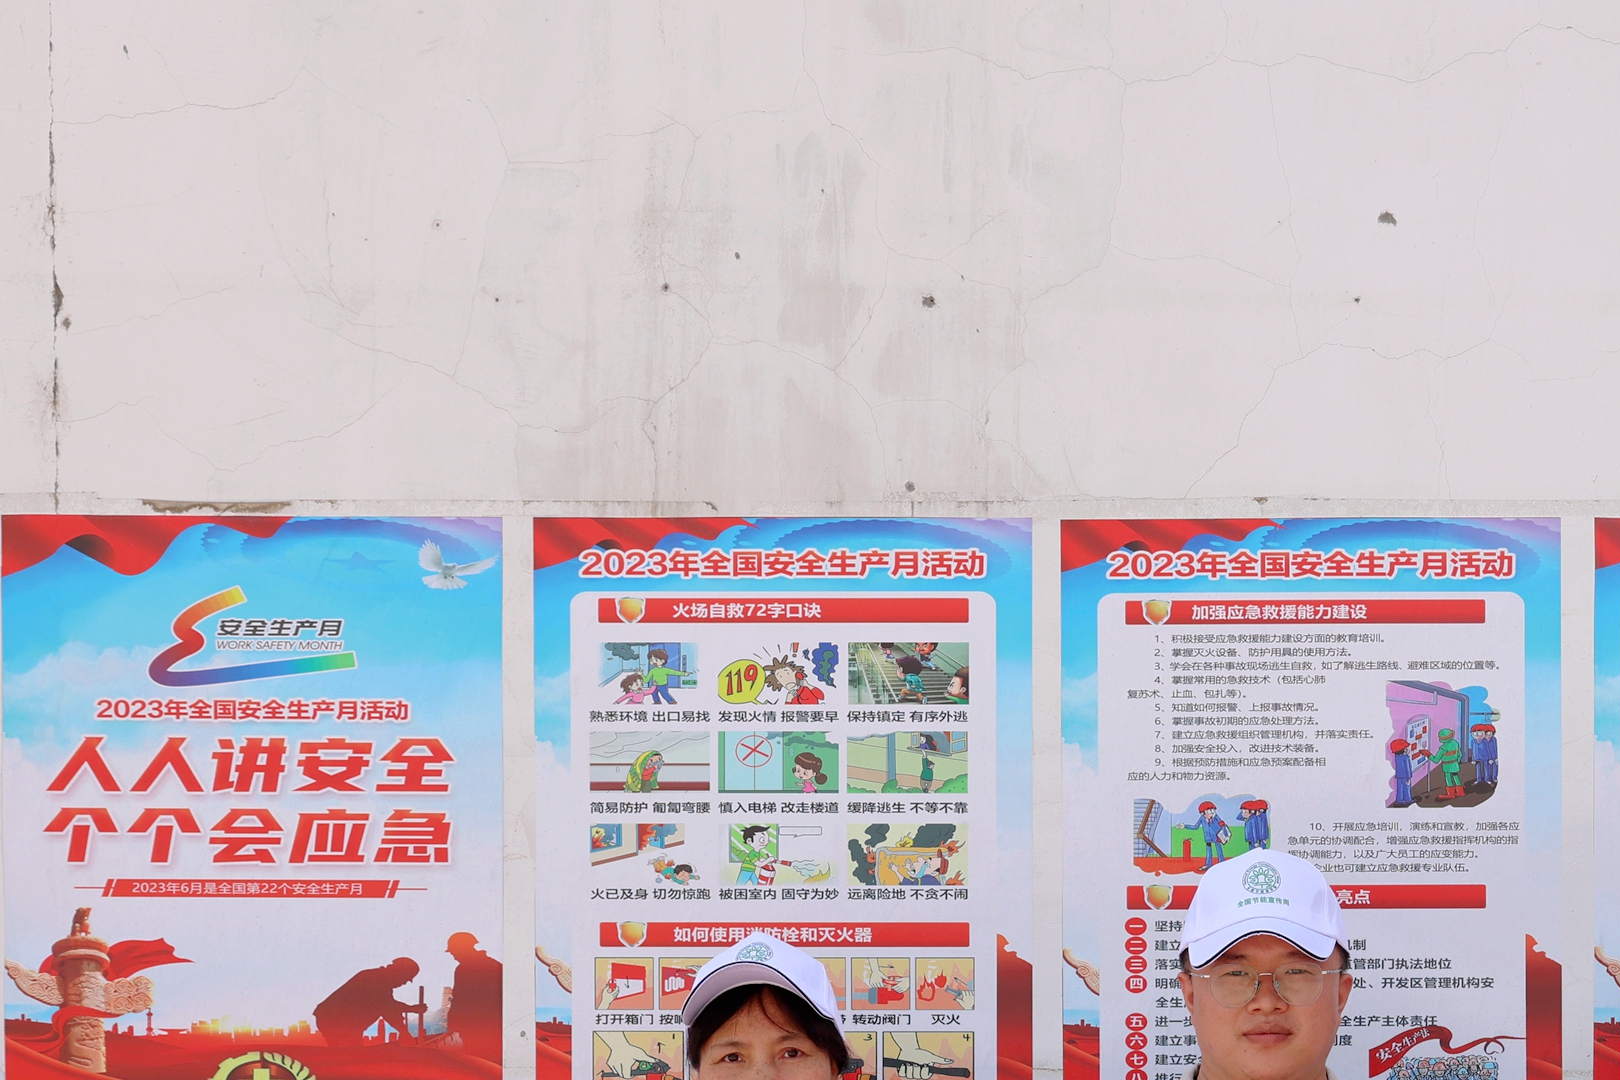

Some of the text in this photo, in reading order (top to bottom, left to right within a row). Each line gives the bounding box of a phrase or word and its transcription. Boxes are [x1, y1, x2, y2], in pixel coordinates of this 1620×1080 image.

[580, 550, 985, 578] 2023年全国安全生产月活动
[1109, 551, 1513, 579] 2023年全国安全生产月活动
[672, 602, 822, 619] 火场自救72字口诀
[1191, 604, 1367, 620] 加强应急救援能力建设
[217, 619, 342, 637] 安全生产月
[216, 640, 344, 651] WORK SAFETY MONTH
[725, 664, 758, 696] 119
[96, 699, 408, 721] 2023年全国安全生产月活动
[589, 710, 710, 723] 熟悉环境 出口易找
[718, 710, 839, 723] 发现火情 报警要早
[847, 710, 968, 723] 保持镇定 有序外逃
[46, 737, 455, 792] 人人讲安全
[590, 801, 648, 814] 简易防护
[719, 801, 839, 814] 慎入电梯 改走楼道
[847, 801, 968, 814] 缓降逃生 不等不靠
[43, 807, 452, 864] 个个会应急
[132, 881, 363, 896] 2023年6月是全国第22个安全生产月
[590, 888, 711, 900] 火已及身 切勿惊跑
[719, 888, 839, 900] 被困室内 固守为妙
[847, 888, 968, 900] 远离险地 不贪不闹
[1237, 896, 1290, 908] 全国节能宣传周
[1130, 978, 1144, 990] 四
[595, 1013, 654, 1025] 打开箱门
[853, 1013, 910, 1025] 转动阀门
[931, 1013, 960, 1025] 灭火
[1130, 1016, 1144, 1028] 五
[1130, 1035, 1144, 1046] 六
[1376, 1028, 1430, 1063] 安全生产法
[1130, 1054, 1144, 1066] 七
